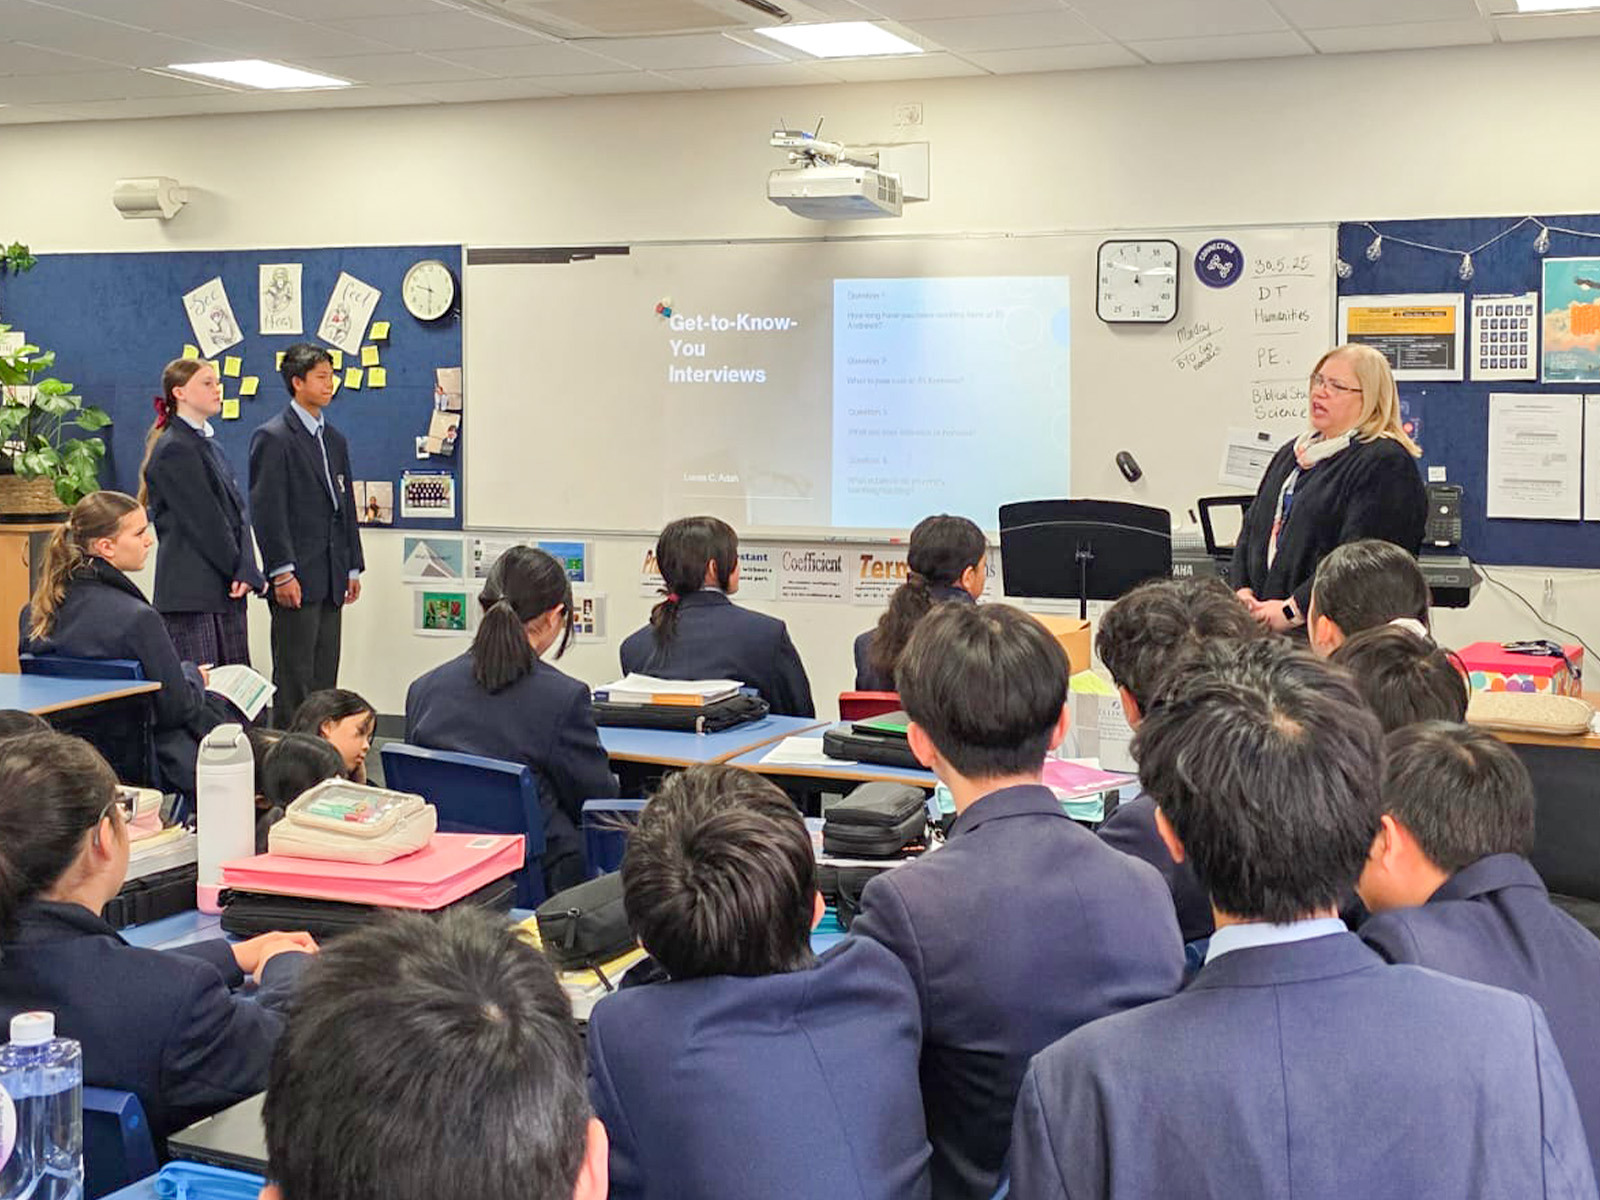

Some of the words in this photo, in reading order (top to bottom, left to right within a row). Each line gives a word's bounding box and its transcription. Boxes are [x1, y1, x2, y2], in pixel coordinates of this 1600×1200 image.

[669, 313, 799, 332] Get-to-Know-
[669, 339, 706, 357] You
[668, 364, 767, 383] Interviews
[1254, 404, 1308, 421] Science
[782, 551, 843, 574] Coefficient
[1172, 563, 1194, 577] AHA
